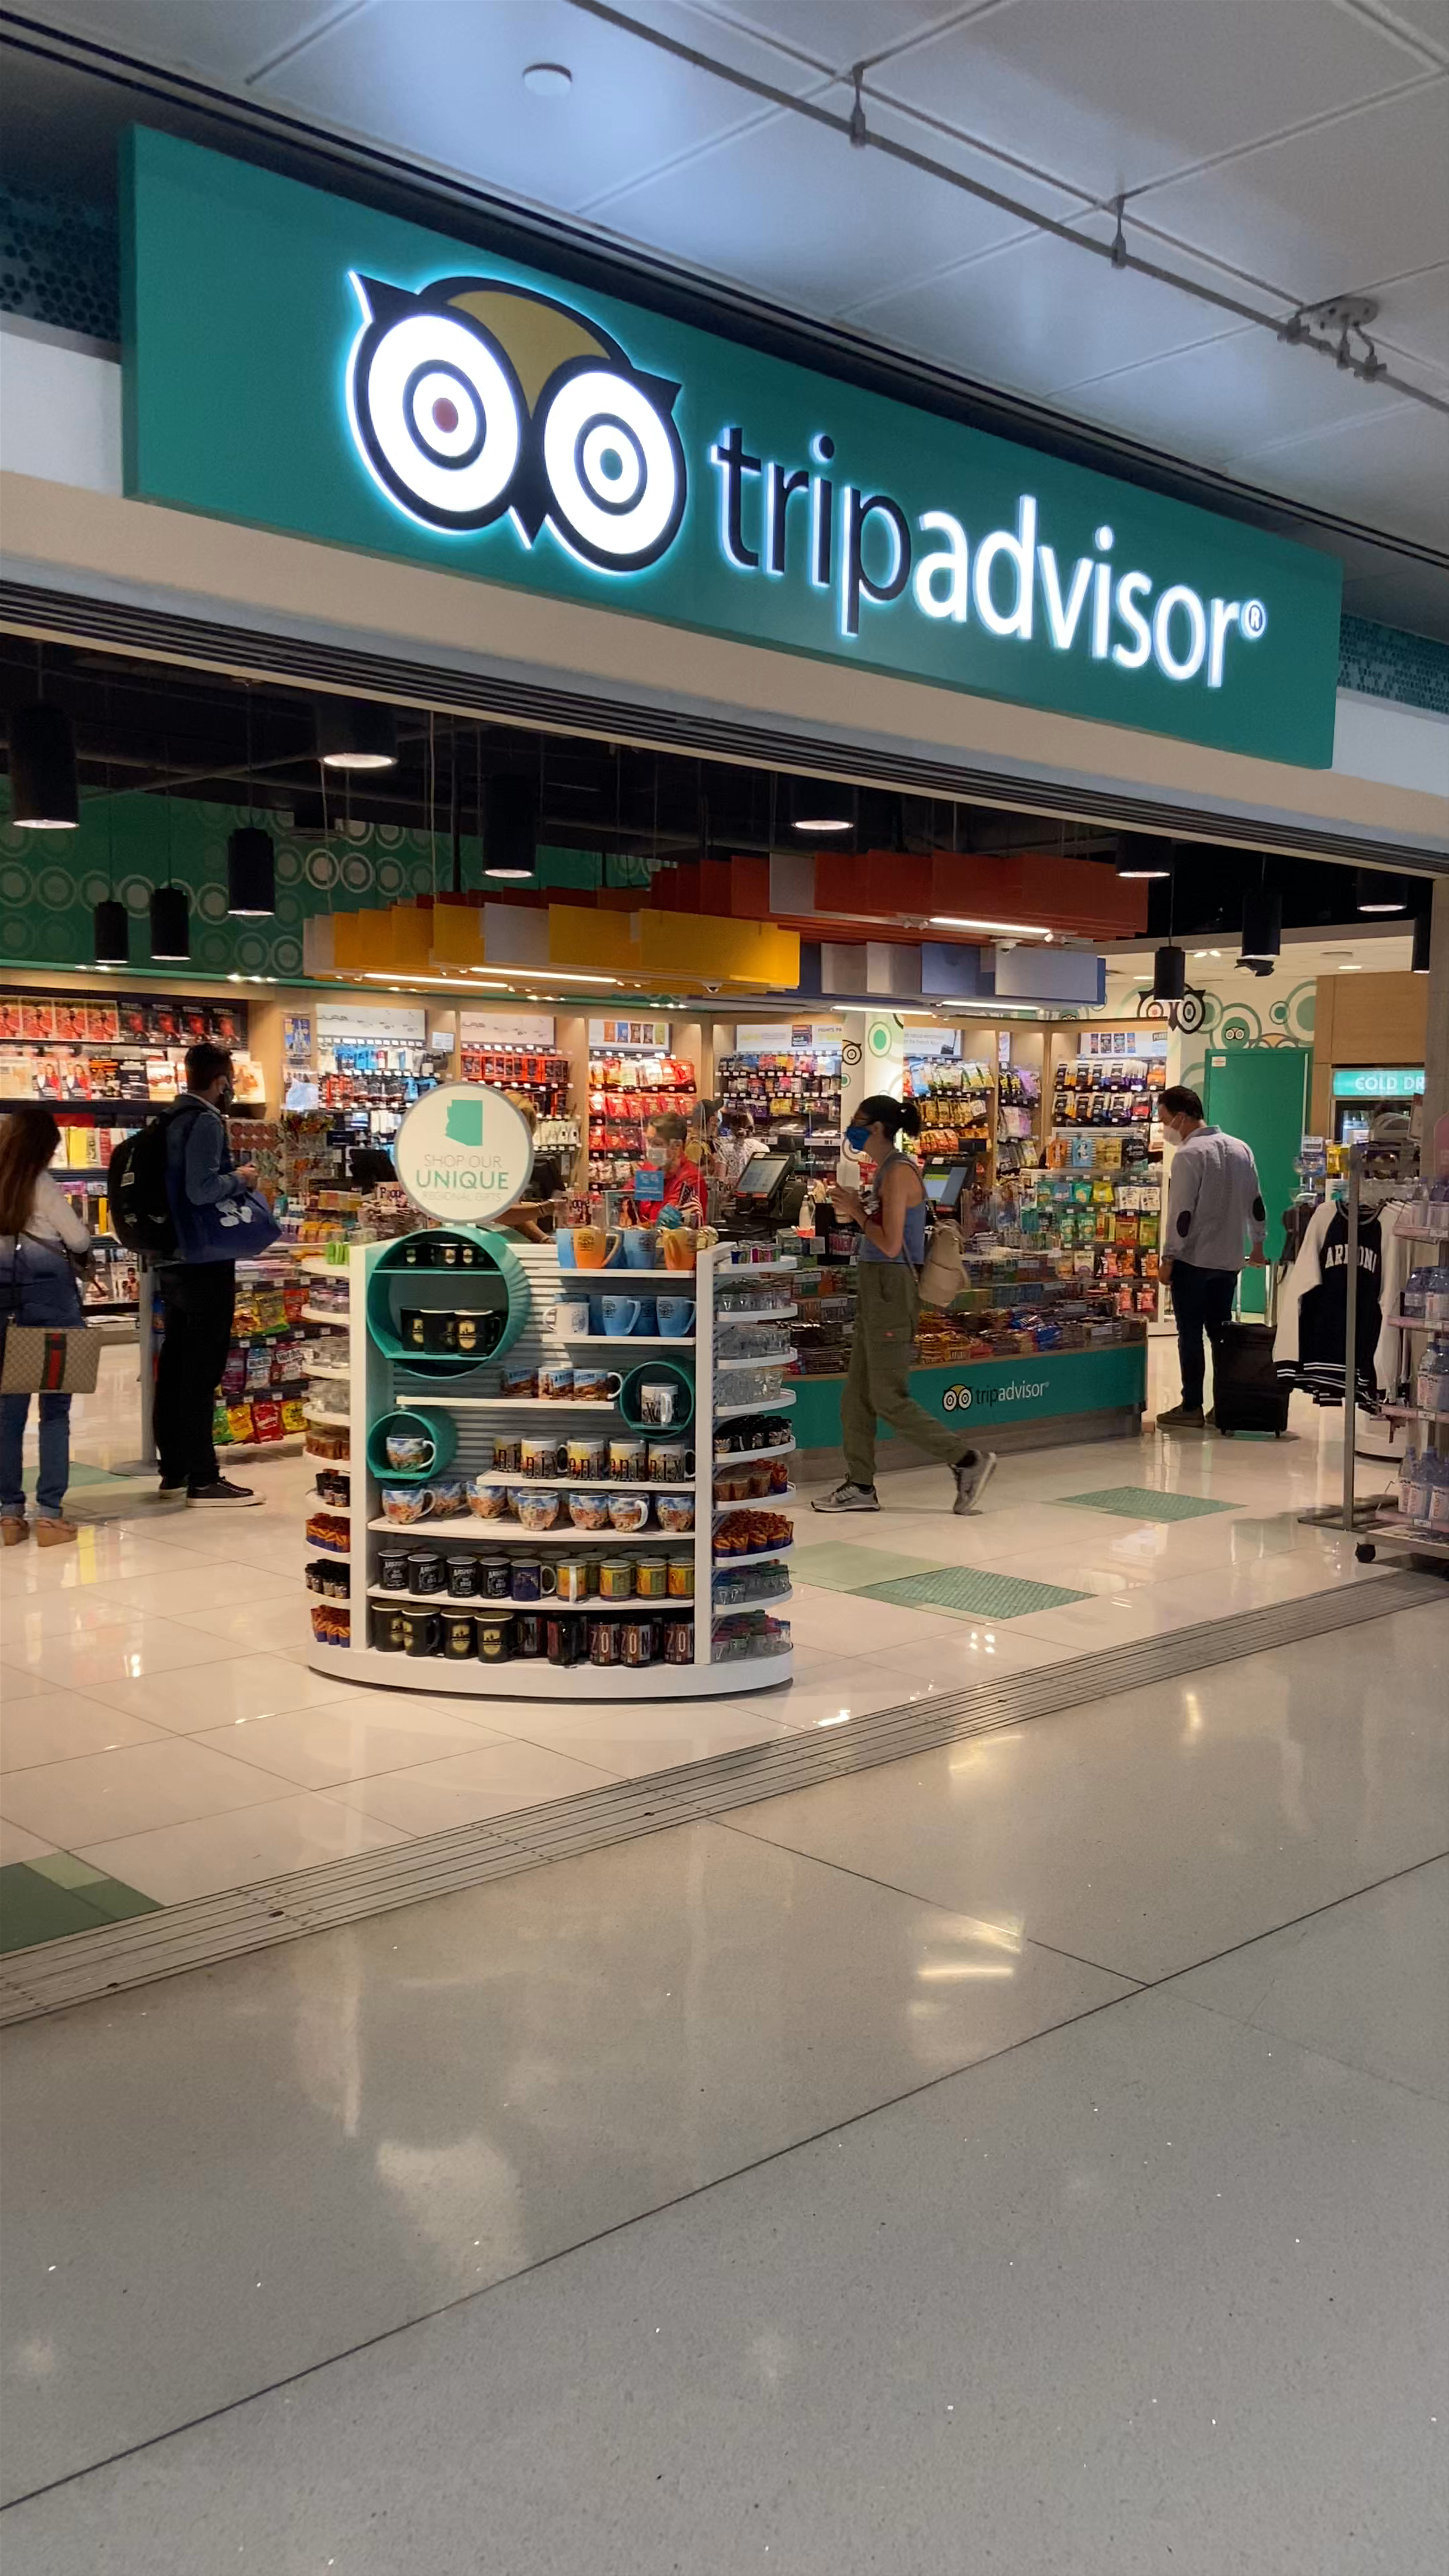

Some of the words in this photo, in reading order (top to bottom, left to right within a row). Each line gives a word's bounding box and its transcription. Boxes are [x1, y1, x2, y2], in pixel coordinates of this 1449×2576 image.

[1355, 1077, 1397, 1090] COLD
[424, 1154, 464, 1168] SHOP
[468, 1155, 502, 1168] OUR
[416, 1169, 509, 1190] UNIQUE
